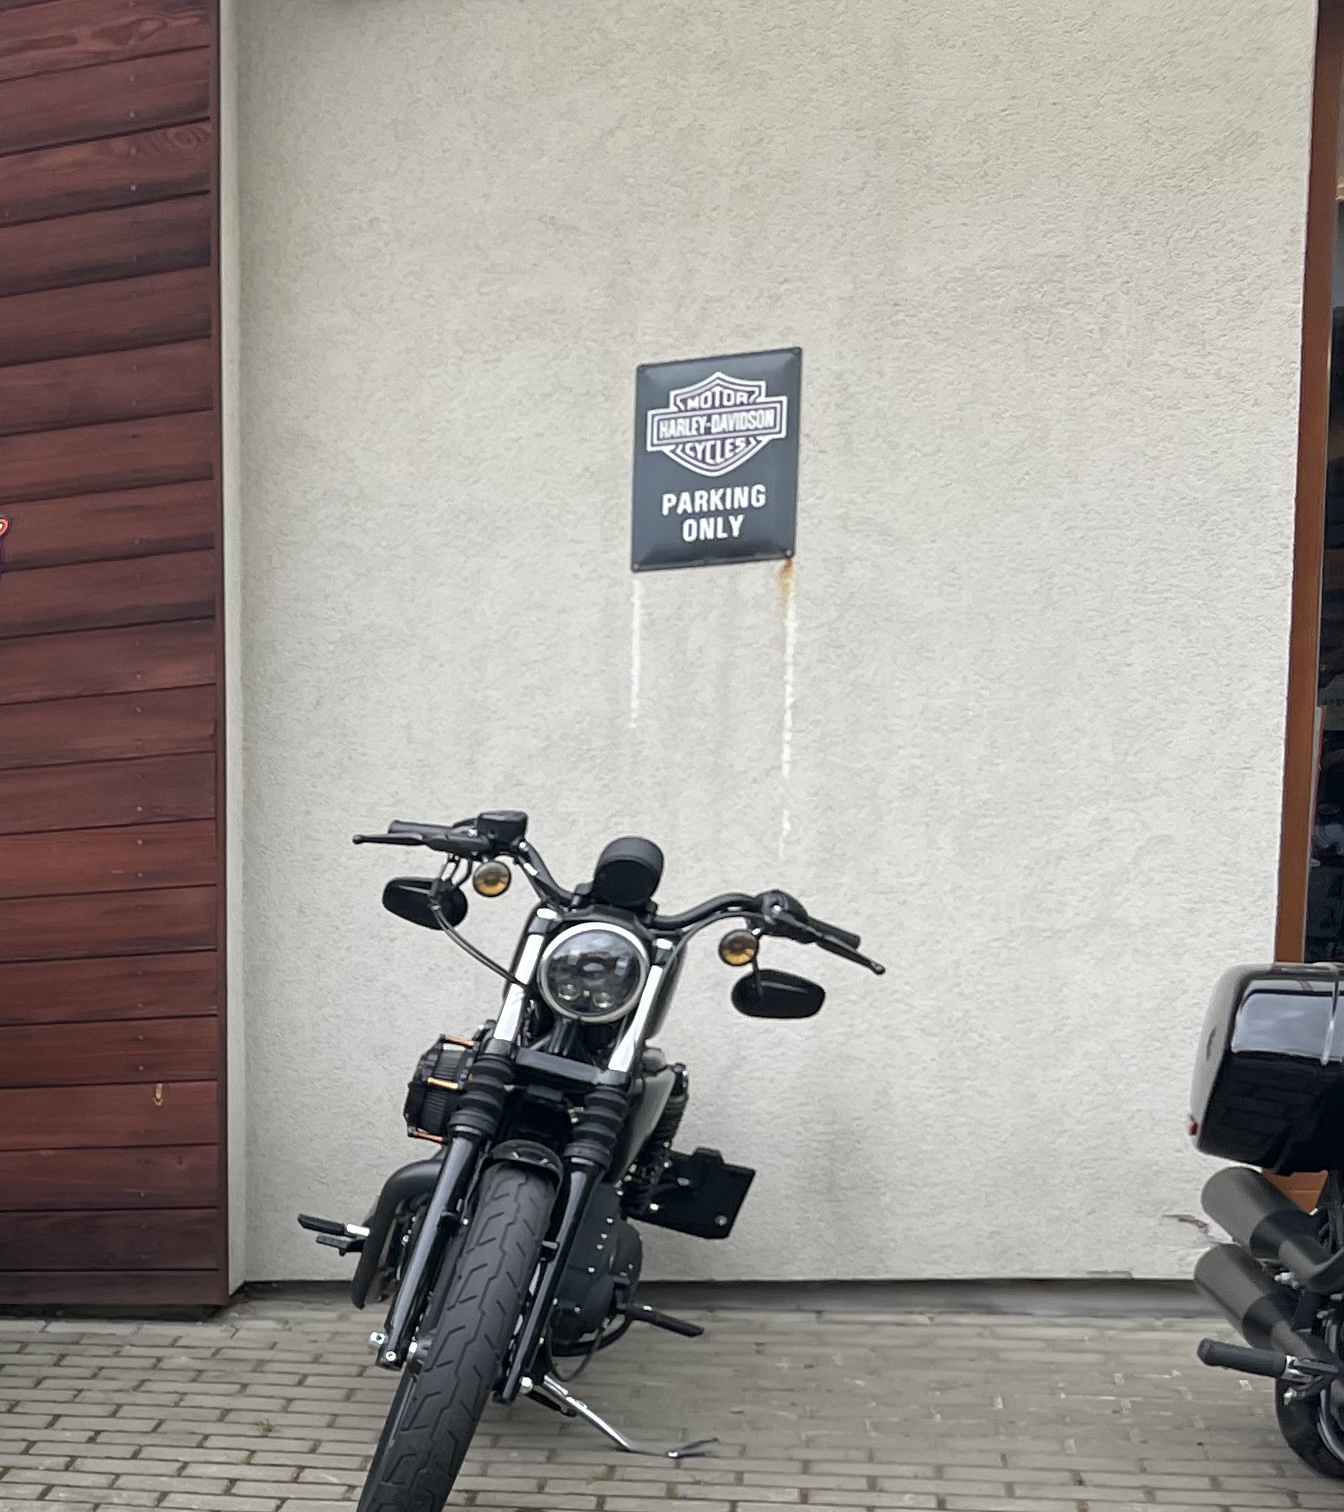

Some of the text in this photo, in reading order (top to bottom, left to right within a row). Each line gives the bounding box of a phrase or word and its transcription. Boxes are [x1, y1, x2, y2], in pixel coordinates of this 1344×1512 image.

[687, 386, 748, 410] MOTOR
[659, 408, 775, 439] HARLEY-DAVIDSON
[685, 437, 747, 464] CYCLES
[662, 484, 766, 516] PARKING
[682, 514, 745, 542] ONLY
